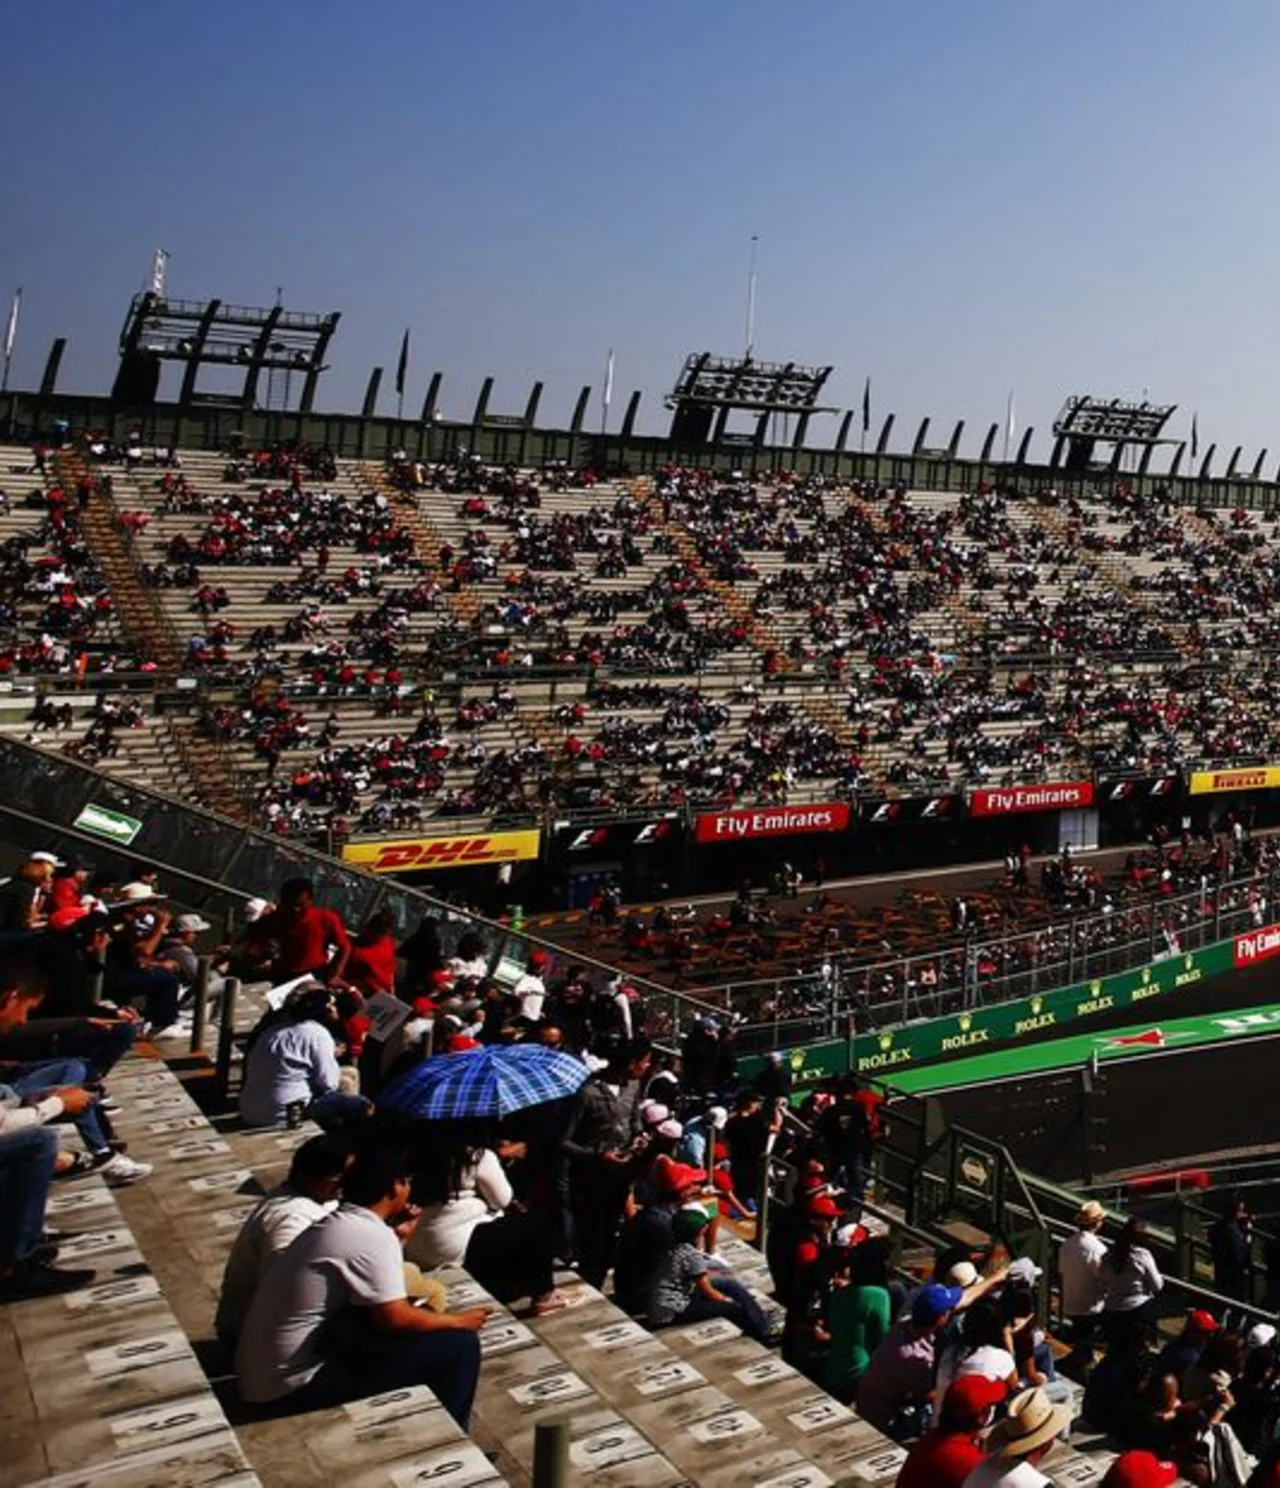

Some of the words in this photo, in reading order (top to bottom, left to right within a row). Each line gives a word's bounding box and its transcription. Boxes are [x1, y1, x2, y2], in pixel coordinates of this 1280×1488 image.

[1213, 770, 1267, 788] PIRELLI
[987, 793, 1013, 811] Fly
[1016, 787, 1079, 806] Emirates
[716, 816, 749, 835] Fly
[752, 810, 832, 831] Emirates
[375, 838, 494, 868] DHL
[1237, 938, 1256, 959] Fly
[1077, 996, 1114, 1016] ROLEX
[1014, 1012, 1057, 1034] ROLEX
[942, 1029, 988, 1051] ROLEX
[858, 1048, 912, 1072] ROLEX
[416, 1460, 465, 1480] 6
